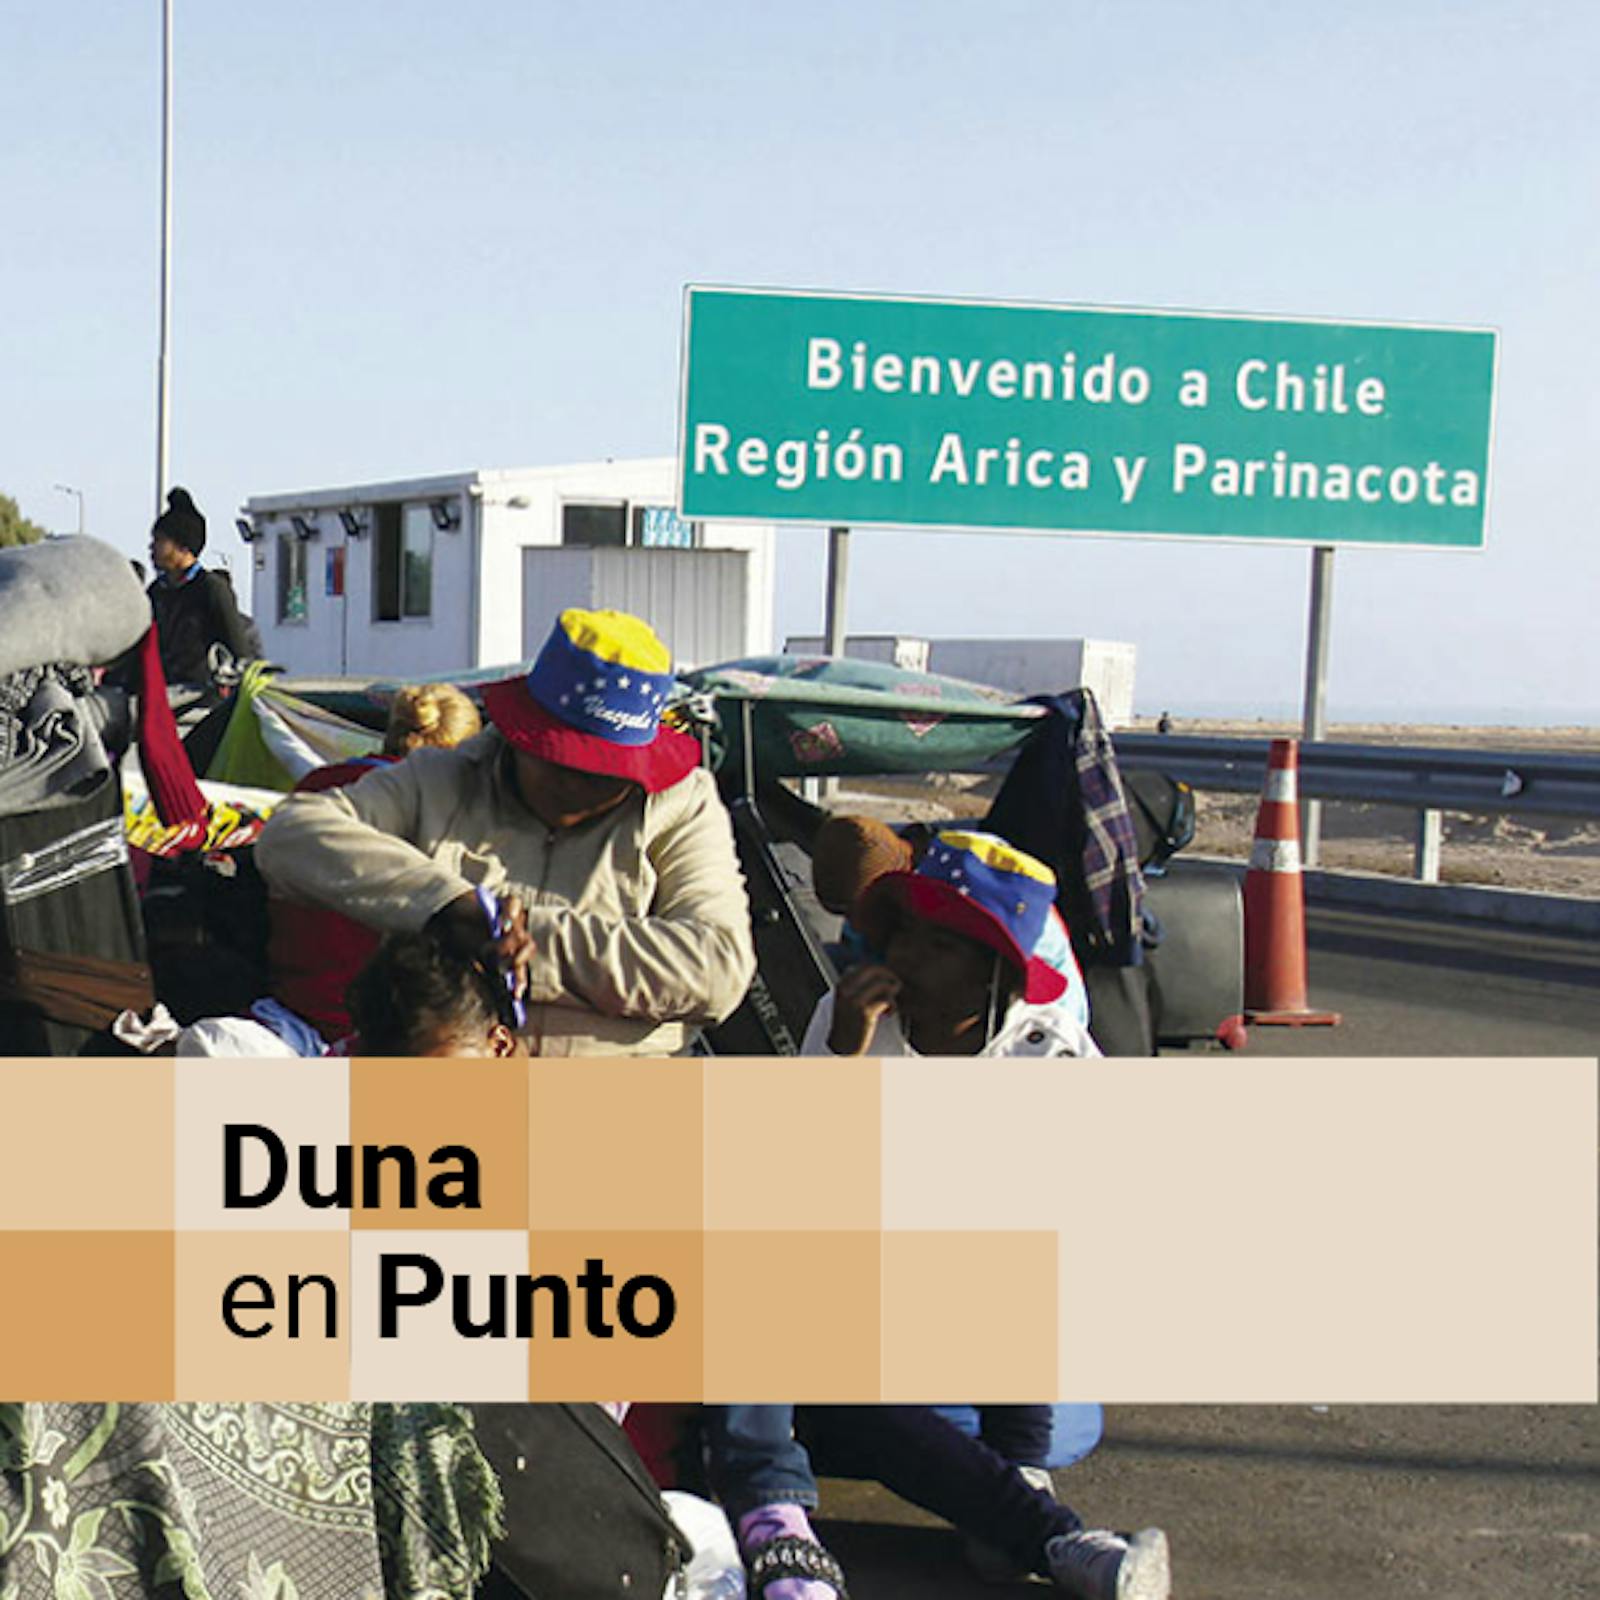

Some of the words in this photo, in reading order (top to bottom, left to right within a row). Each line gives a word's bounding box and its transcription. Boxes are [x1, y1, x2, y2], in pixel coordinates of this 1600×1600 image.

[807, 337, 1152, 406] Bienvenido
[1178, 369, 1210, 408] a
[1235, 358, 1387, 417] Chile
[693, 422, 903, 490] Región
[929, 432, 1091, 490] Arica
[1113, 455, 1149, 505] y
[1172, 441, 1481, 508] Parinacota
